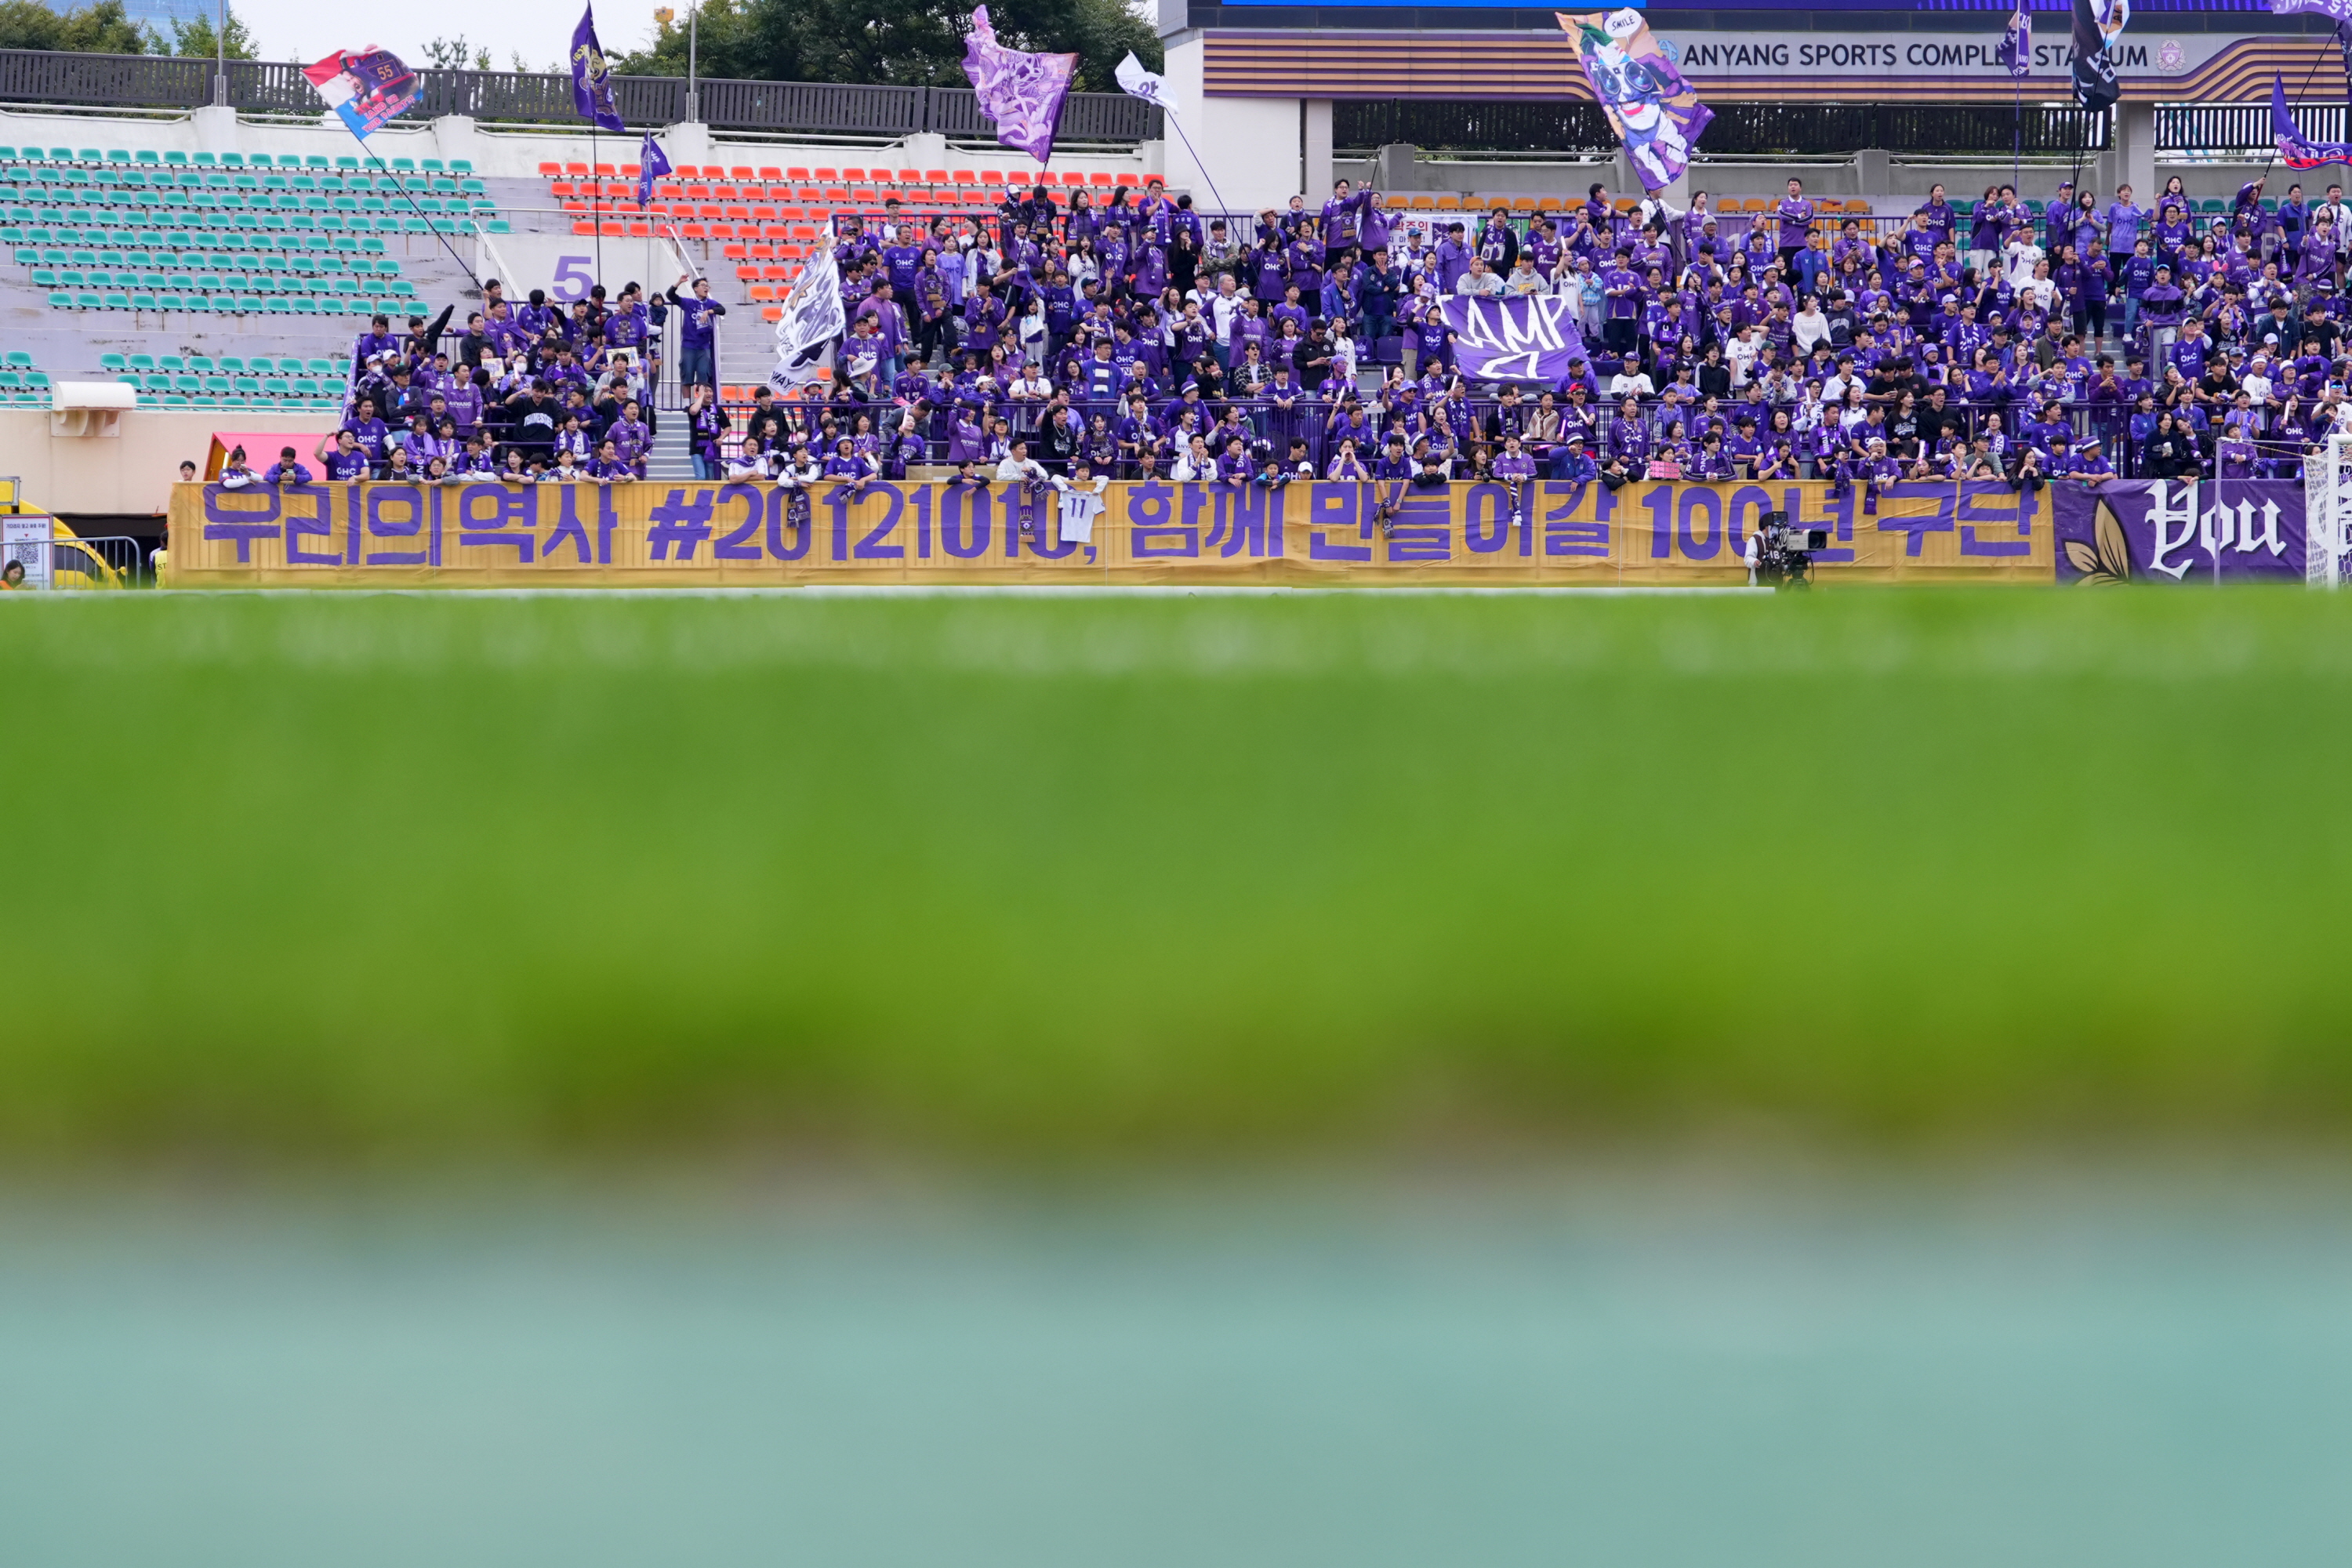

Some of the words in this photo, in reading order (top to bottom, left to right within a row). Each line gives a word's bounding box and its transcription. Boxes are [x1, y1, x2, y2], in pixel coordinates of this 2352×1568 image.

[1612, 15, 1635, 31] SMILE
[1683, 45, 1789, 66] ANYANG
[1799, 44, 1896, 66] SPORTS
[1907, 44, 2007, 67] COMPL
[2034, 45, 2148, 66] STUM
[376, 64, 394, 81] 55
[361, 117, 383, 132] YOUR
[552, 256, 594, 301] 5
[1425, 335, 1442, 343] OHC
[1662, 325, 1669, 338] FC
[2180, 353, 2198, 362] OHC
[358, 435, 377, 444] OHC
[336, 467, 357, 476] OHC
[1071, 498, 1087, 518] 11
[202, 481, 441, 566] 우리의
[459, 481, 618, 564] 역사
[648, 481, 1097, 564] #20121010,
[1127, 480, 1283, 560] 함께
[1878, 480, 2039, 557] 구단
[2144, 478, 2288, 580] You
